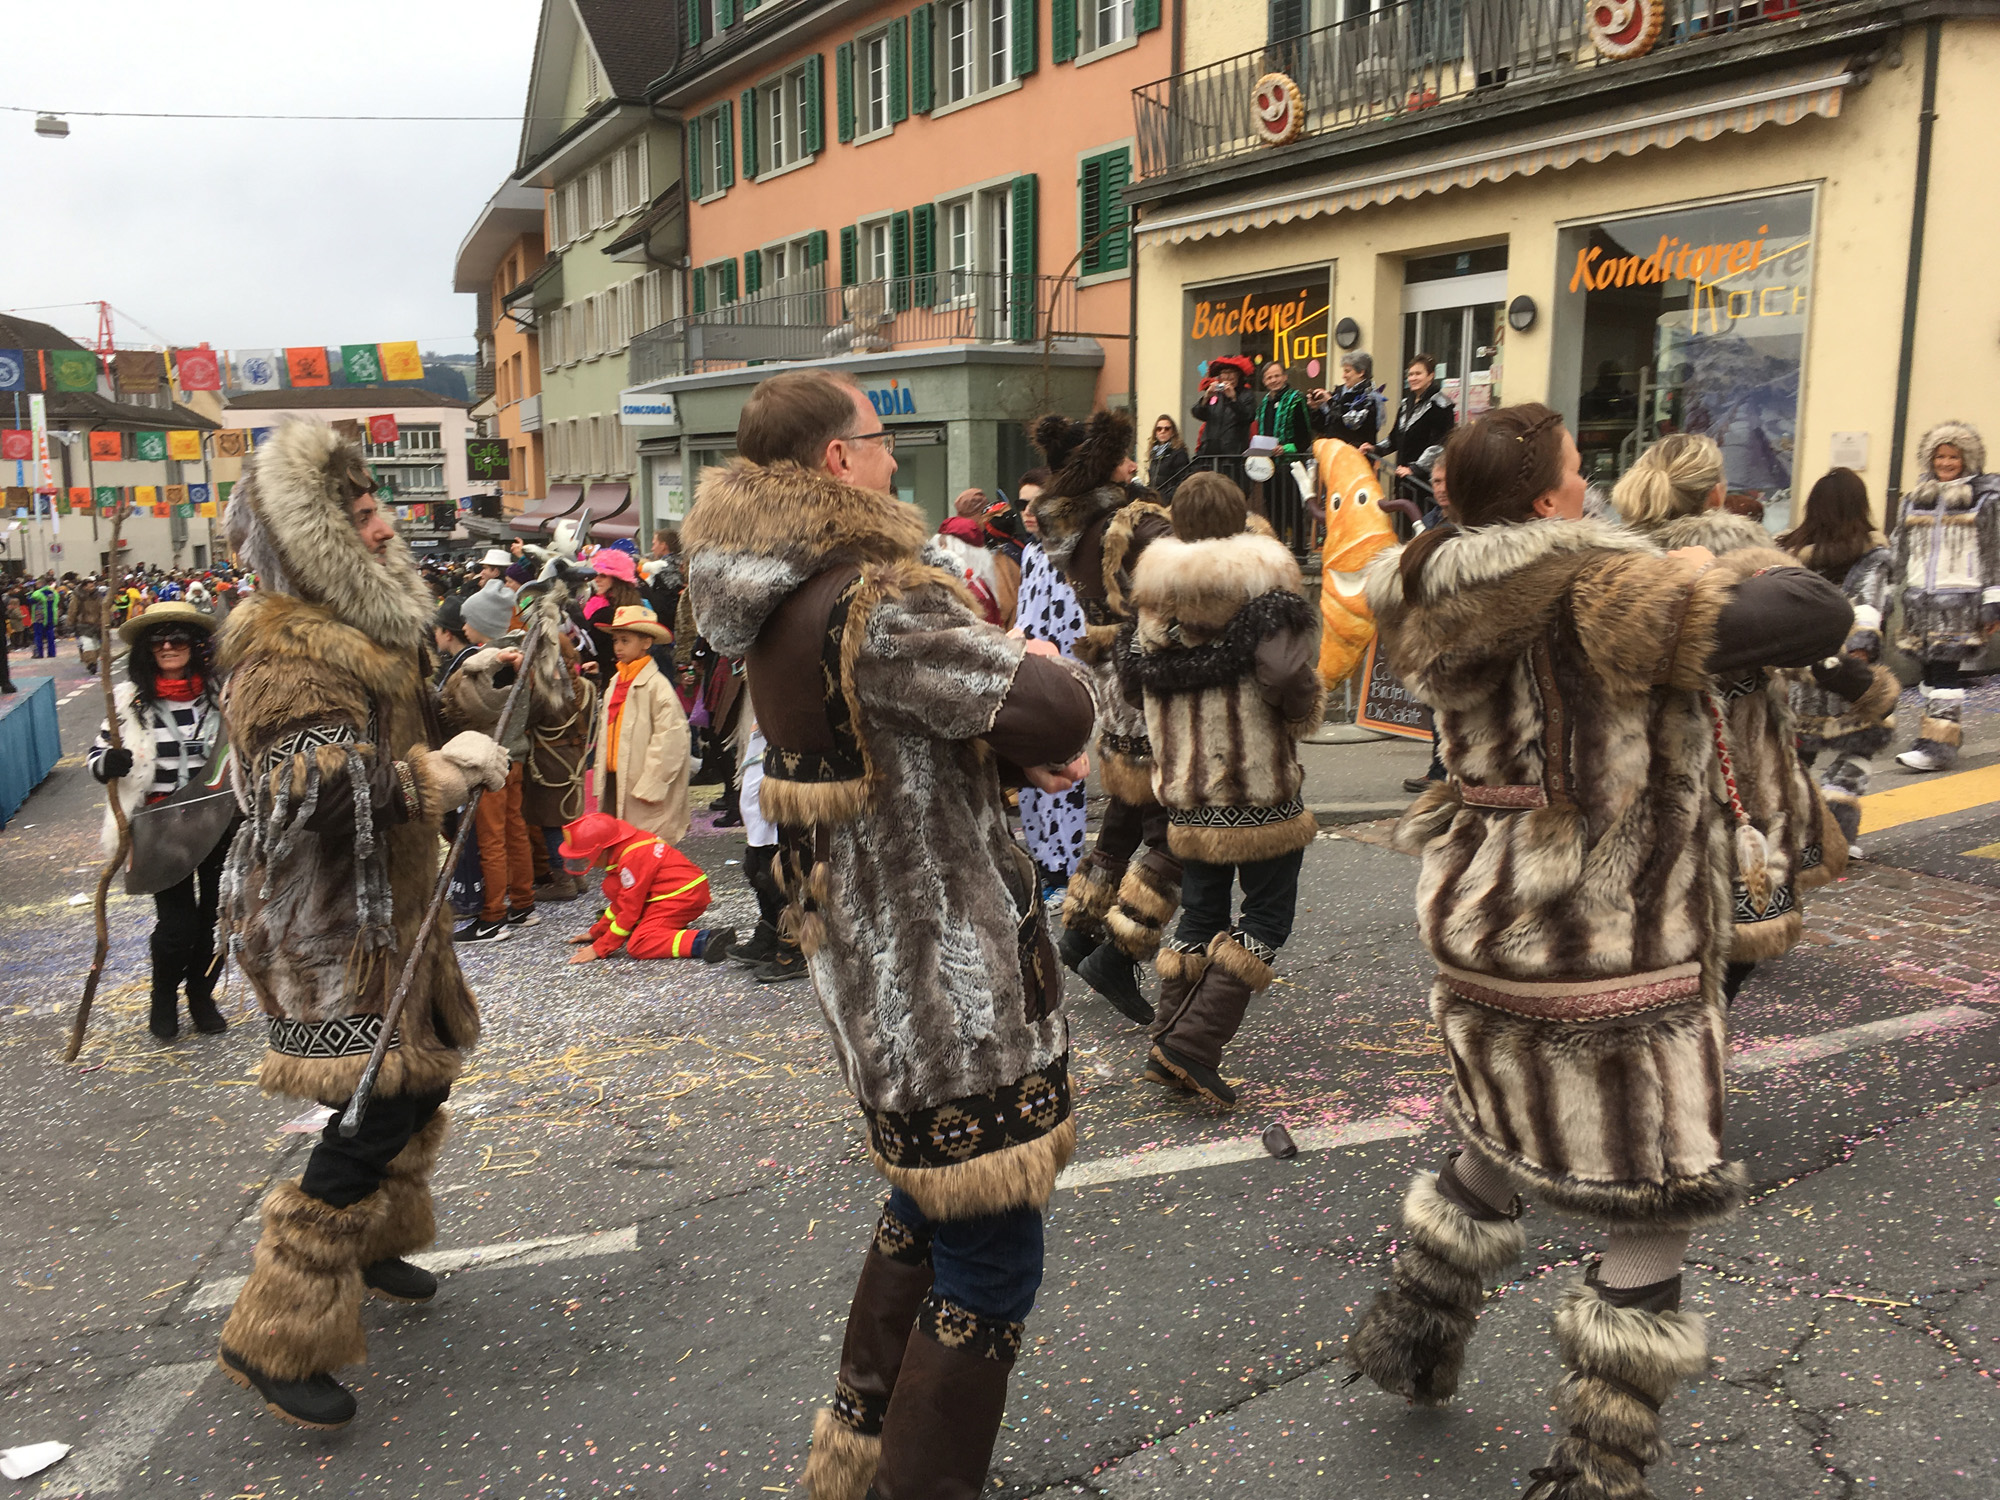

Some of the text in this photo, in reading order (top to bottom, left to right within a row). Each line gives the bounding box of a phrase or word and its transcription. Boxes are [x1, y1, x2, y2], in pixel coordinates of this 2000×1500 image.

[1569, 224, 1769, 293] Konditorei
[1191, 289, 1308, 339] Bäckerei
[623, 402, 673, 415] CONCORDIA
[467, 442, 501, 457] Café
[474, 456, 509, 478] Bijou
